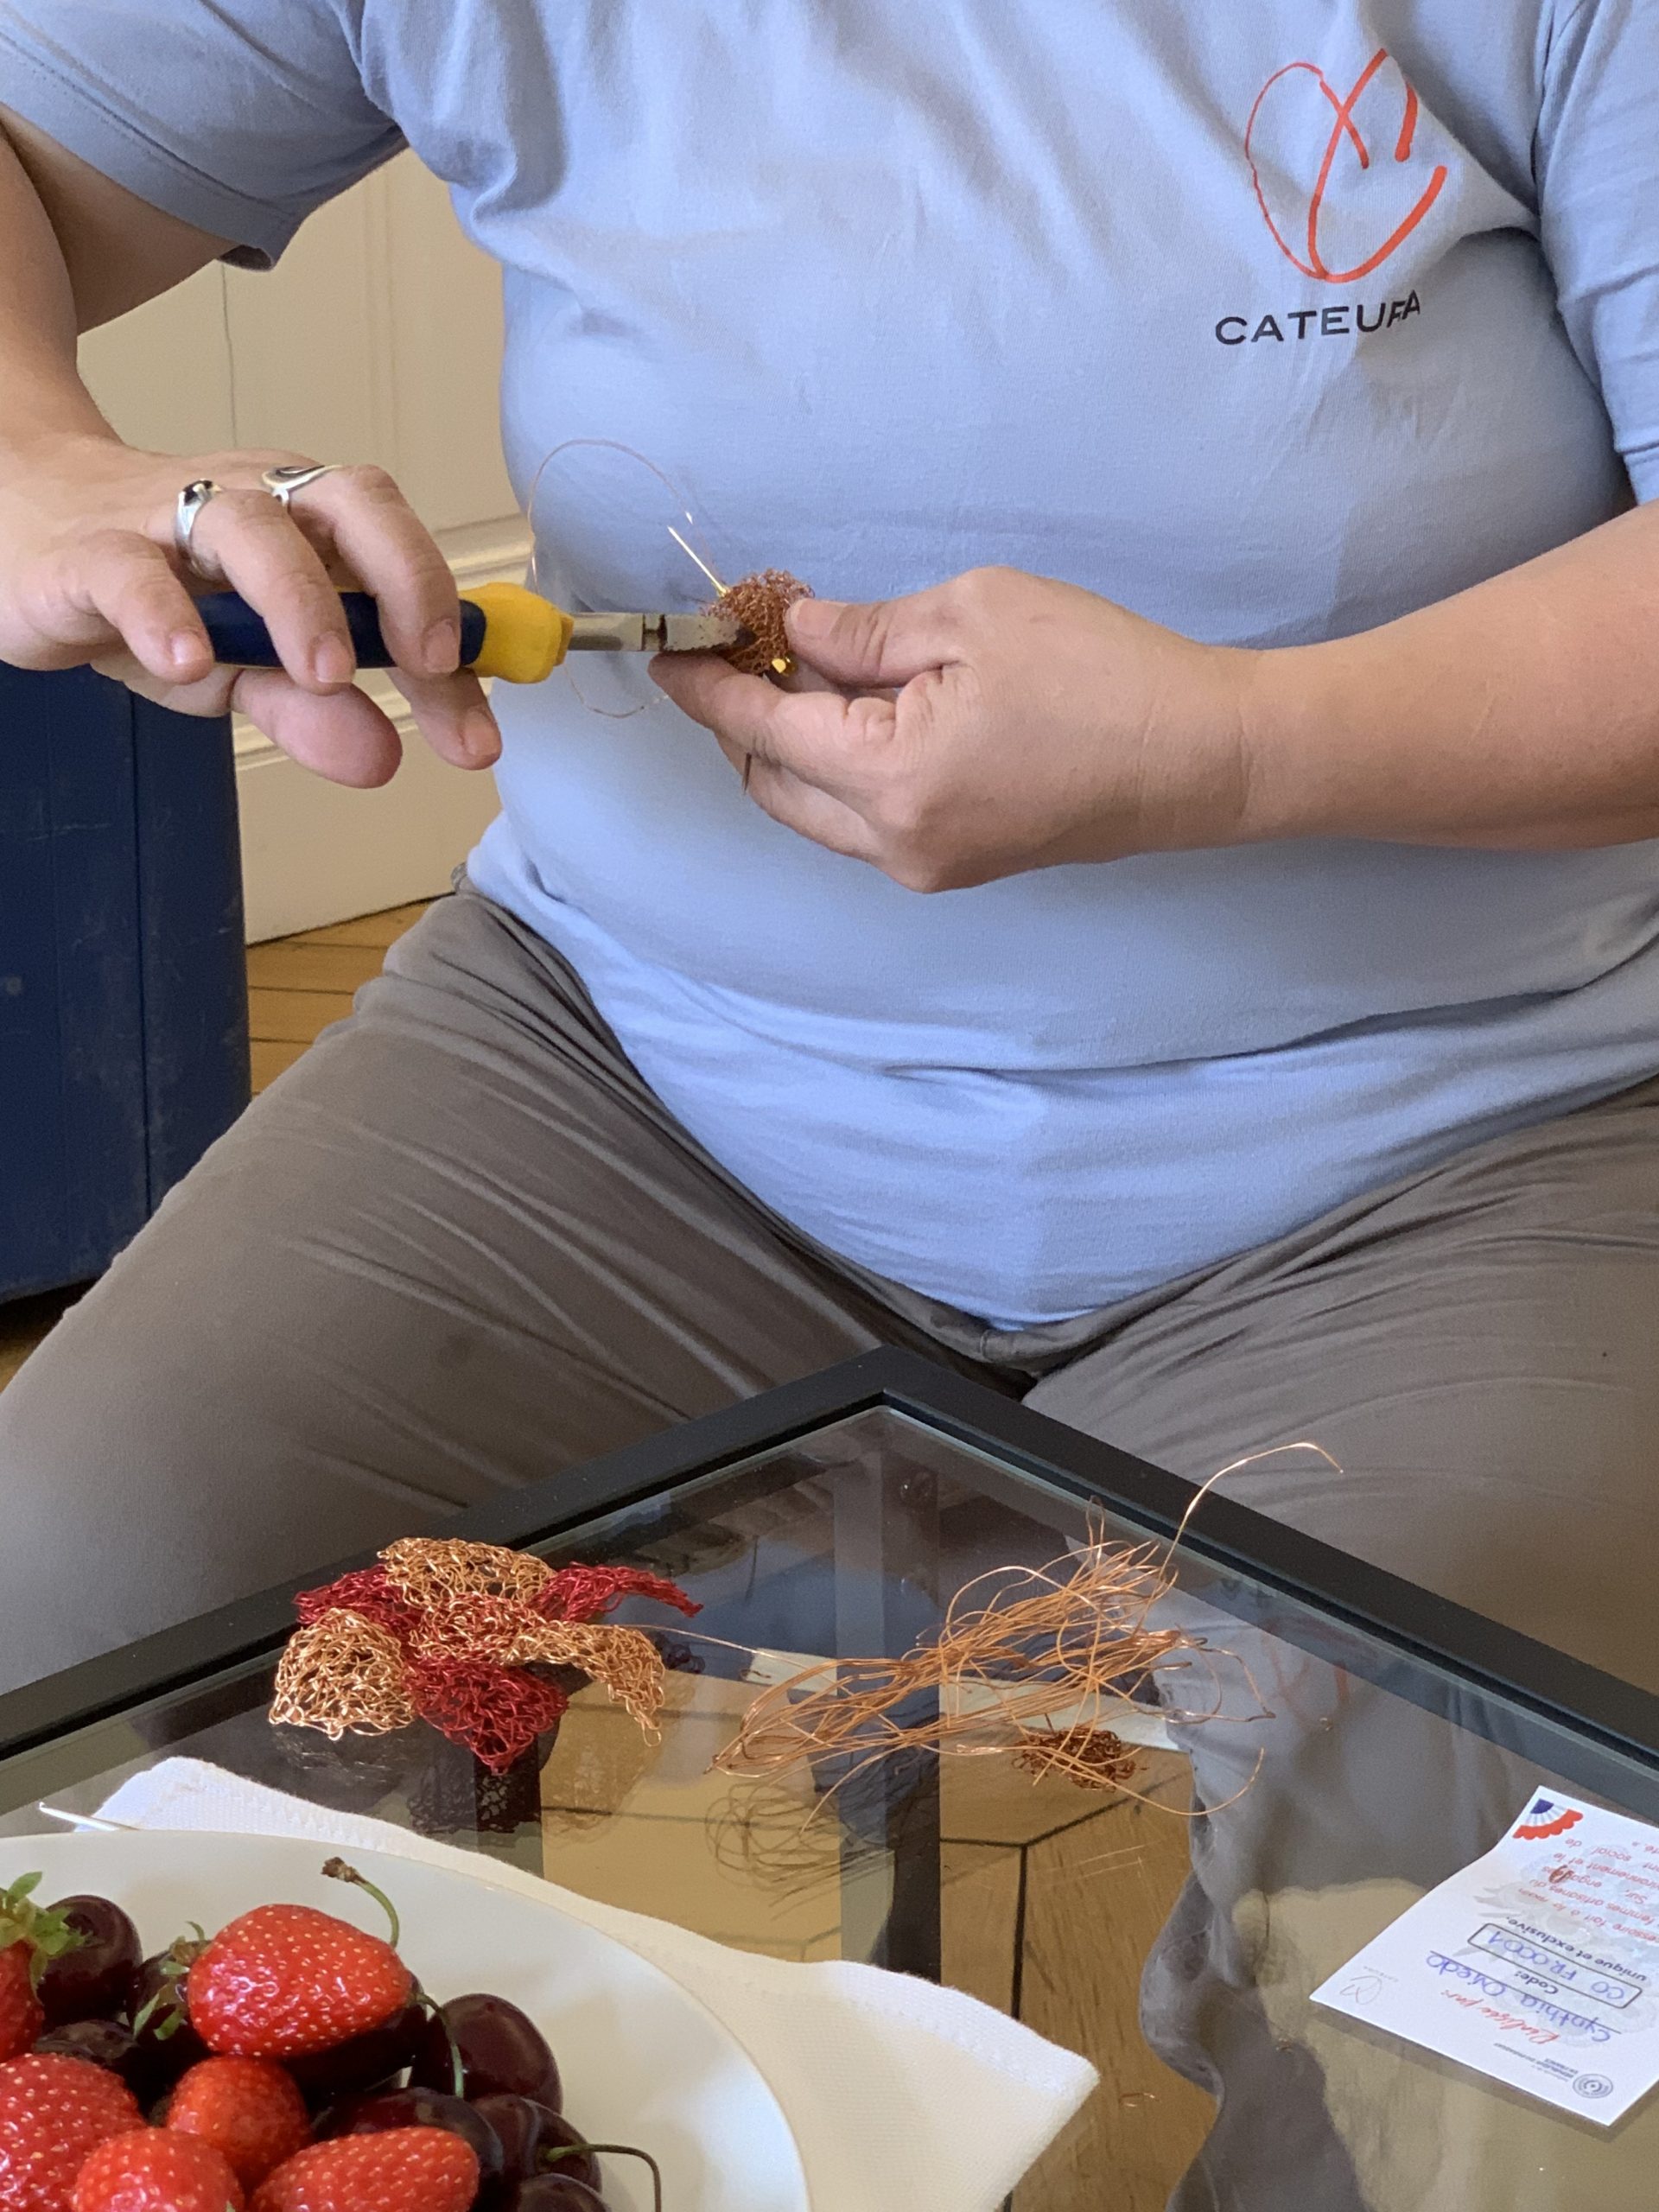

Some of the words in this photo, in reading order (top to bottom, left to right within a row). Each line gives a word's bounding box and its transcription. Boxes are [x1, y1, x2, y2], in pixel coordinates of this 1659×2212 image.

[1590, 1847, 1632, 1861] social
[1605, 1903, 1656, 1925] femmes
[1505, 1916, 1574, 1952] exclusive.
[1576, 1949, 1592, 1960] et
[1426, 1953, 1506, 1997] Oviedo
[1594, 1958, 1647, 1981] unique
[1515, 1971, 1559, 1994] Code:
[1521, 1993, 1611, 2042] Cynthia
